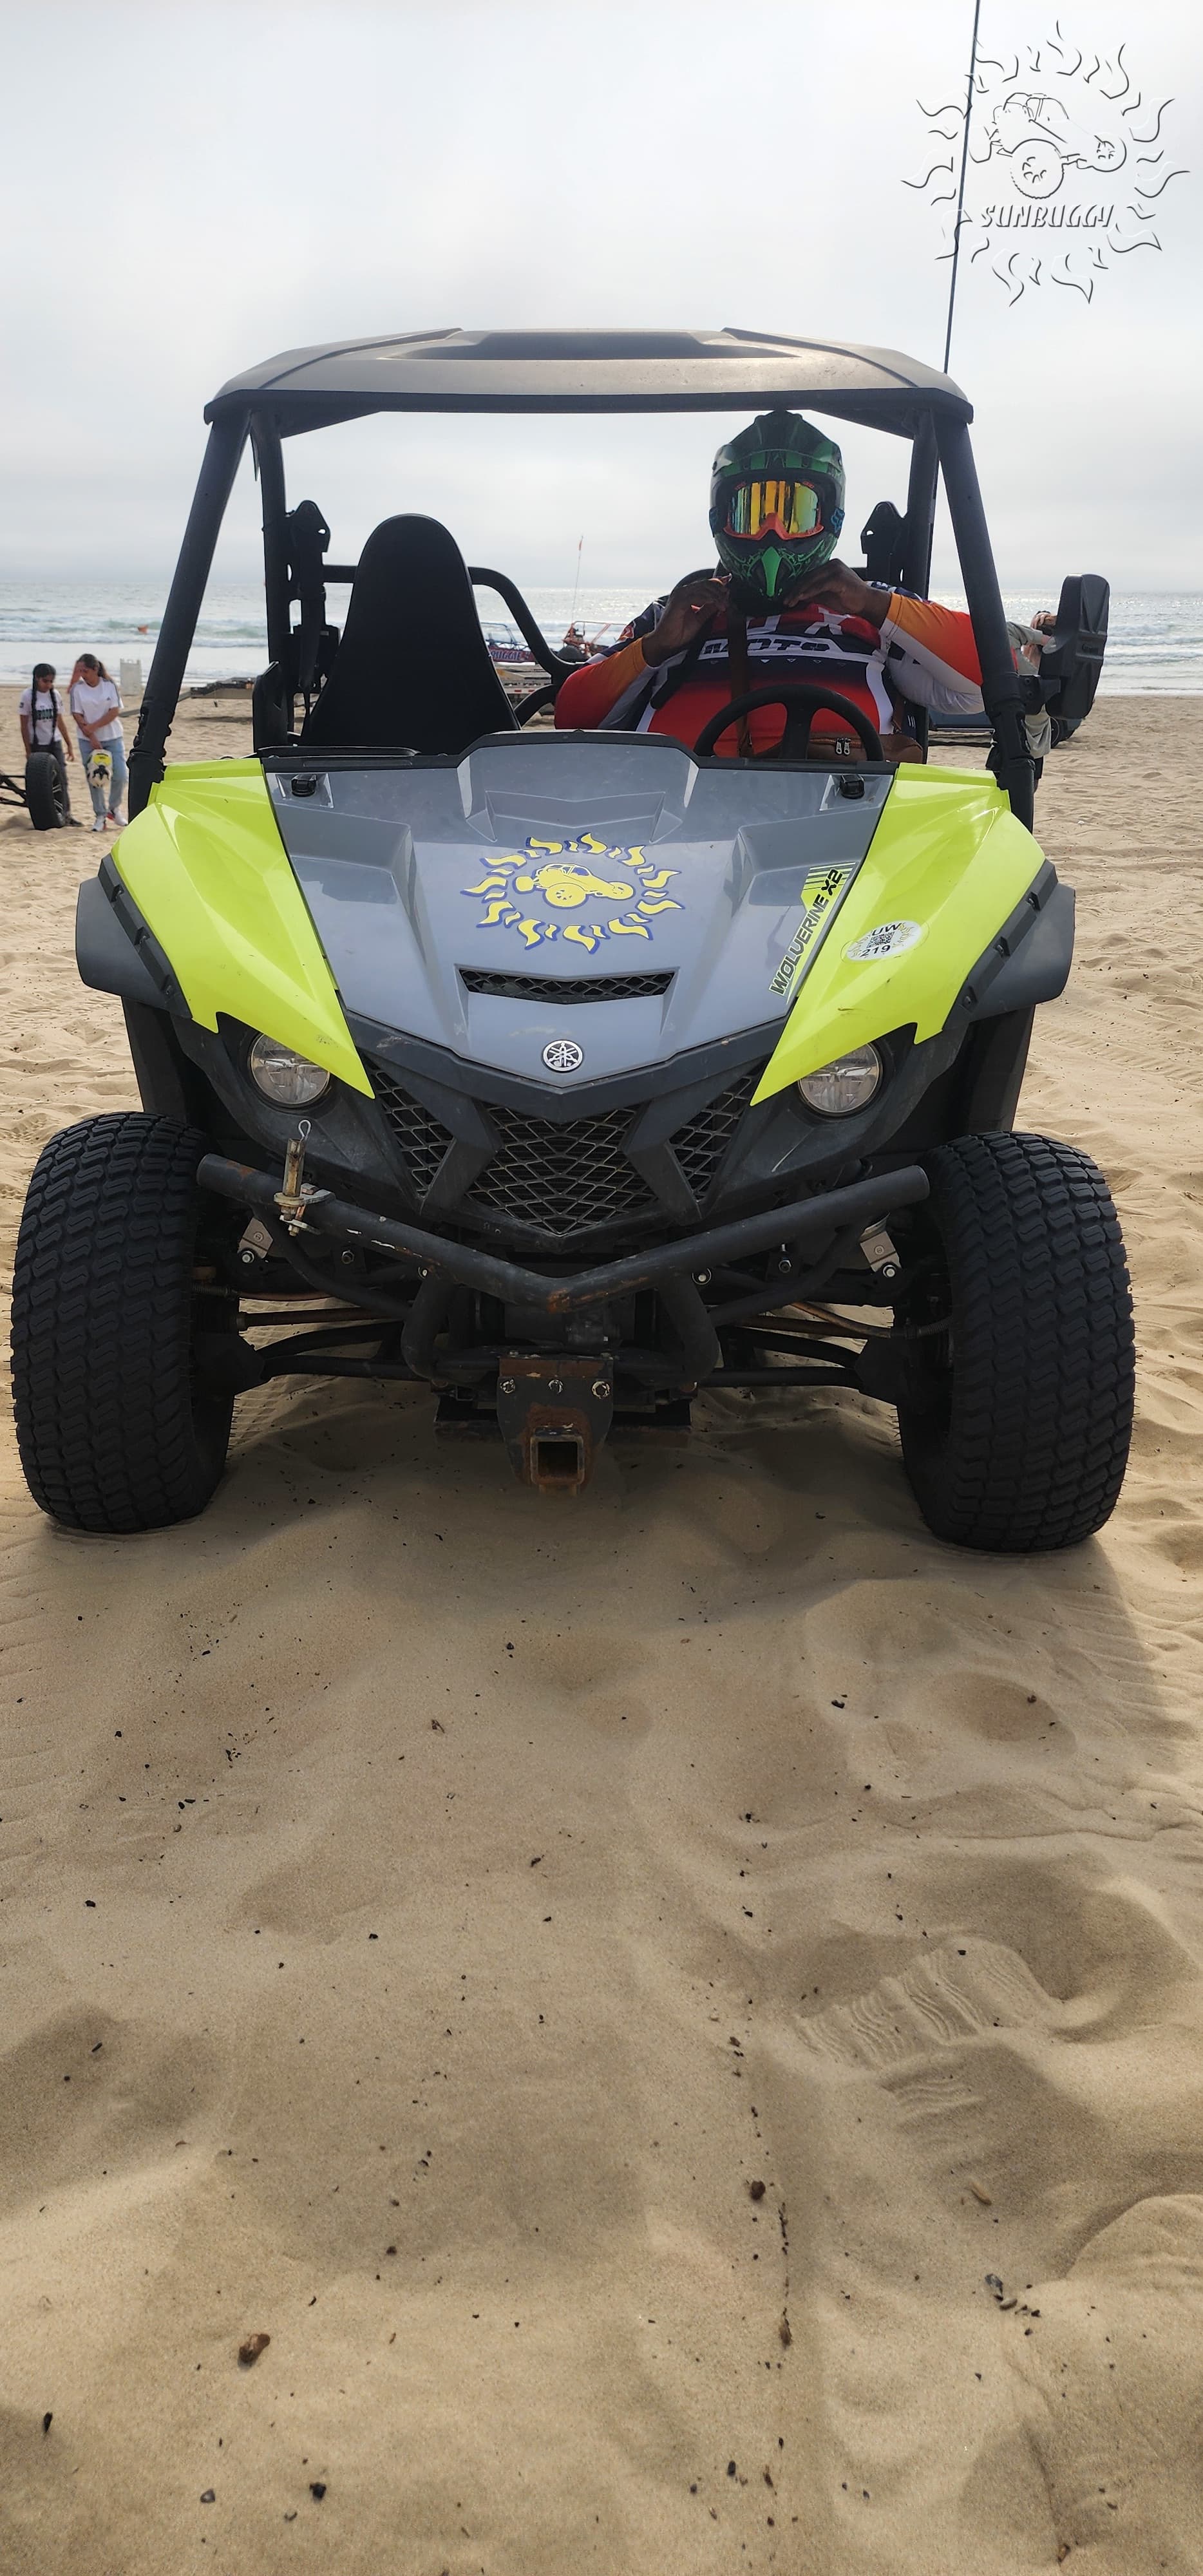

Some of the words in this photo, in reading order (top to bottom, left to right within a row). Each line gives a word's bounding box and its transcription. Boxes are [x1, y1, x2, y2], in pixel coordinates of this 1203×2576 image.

[769, 894, 829, 996] WOLVERINE
[821, 869, 843, 896] X2
[872, 922, 902, 936] UW
[860, 945, 891, 958] 219
